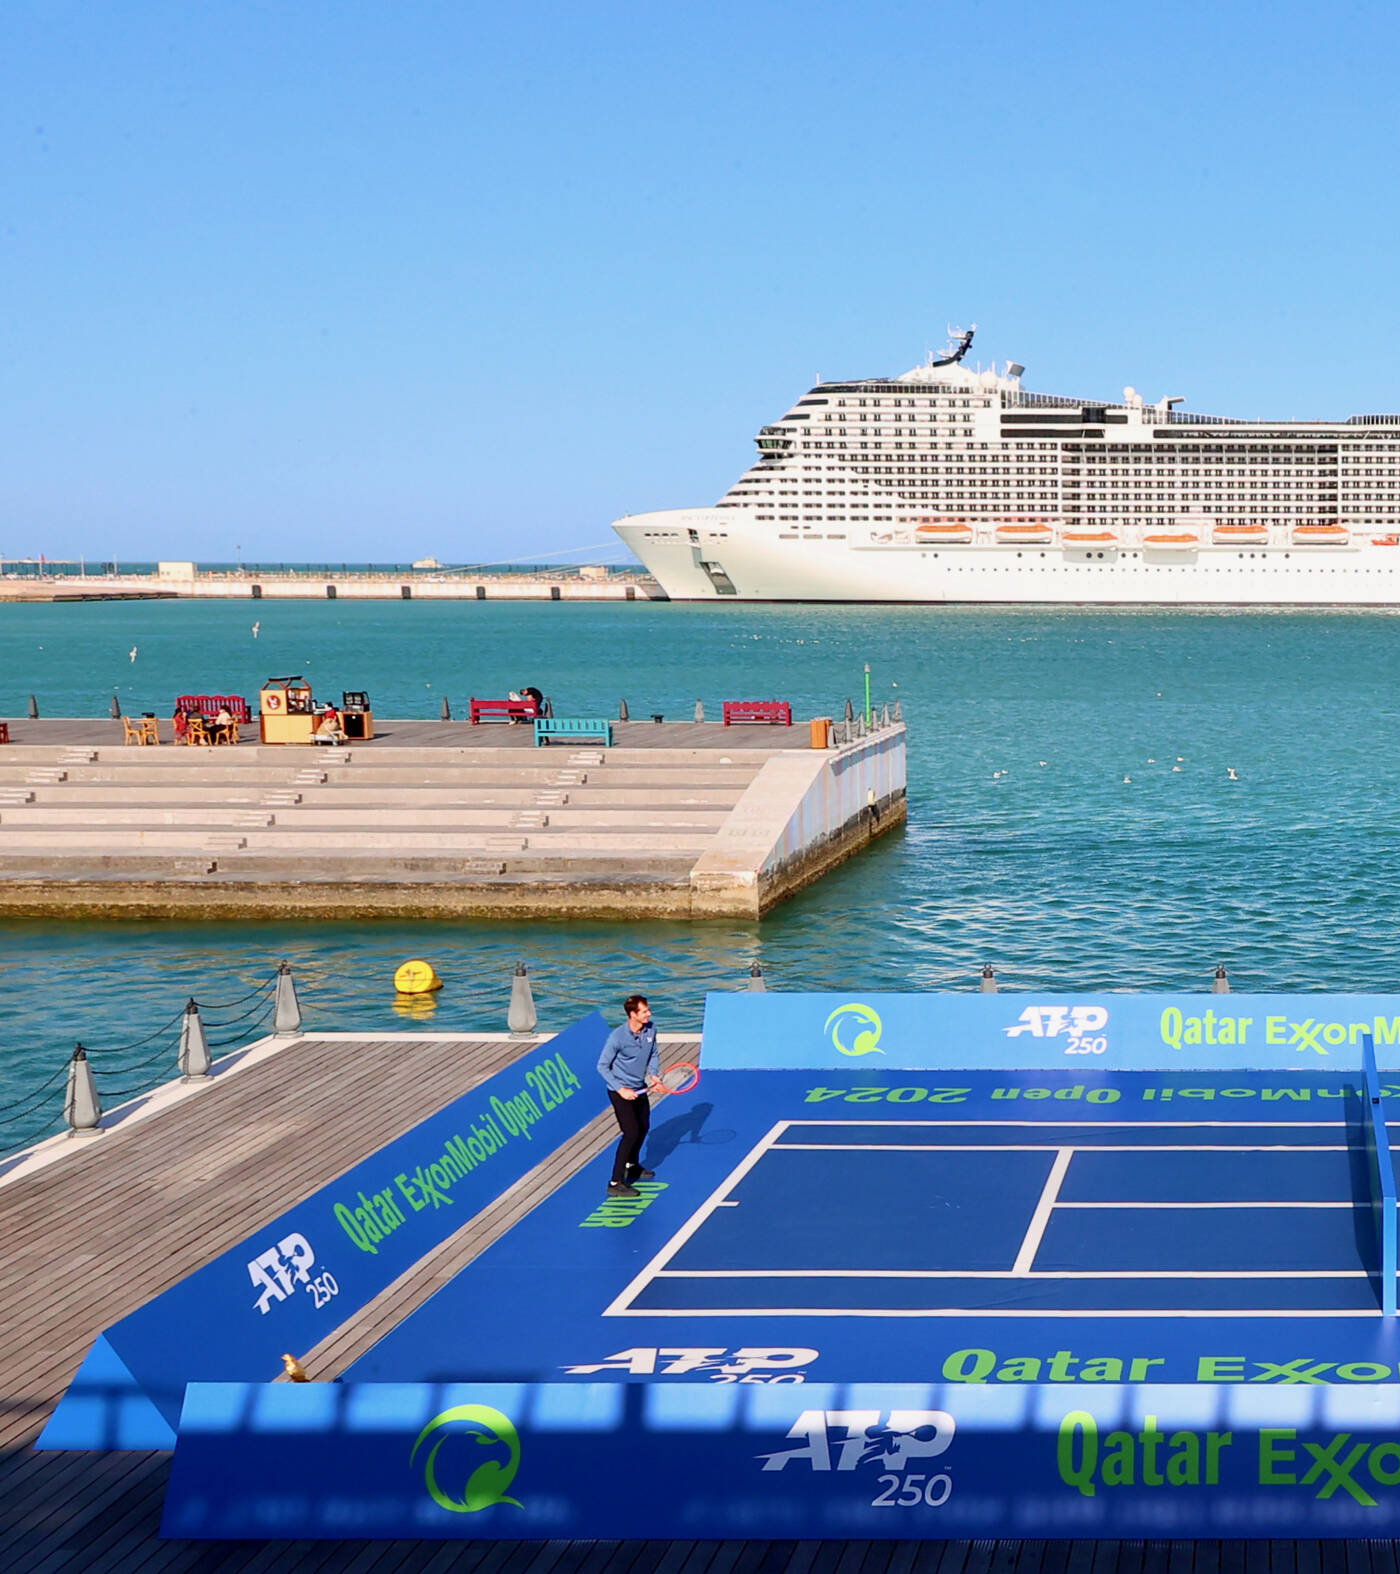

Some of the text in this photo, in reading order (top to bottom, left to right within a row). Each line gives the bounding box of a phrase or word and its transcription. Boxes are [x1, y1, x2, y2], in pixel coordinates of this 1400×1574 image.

[1002, 1005, 1109, 1037] ATP
[1160, 1007, 1252, 1049] Qatar
[1063, 1036, 1108, 1055] 250
[804, 1087, 973, 1103] 2024
[991, 1086, 1121, 1103] Open
[333, 1053, 581, 1255] Qatar ExxonMobil Open 2024
[247, 1232, 316, 1315] ATP
[305, 1271, 340, 1310] 250
[556, 1347, 820, 1374] ATP
[942, 1349, 1165, 1383] Qatar
[752, 1410, 957, 1471] ATP
[1057, 1410, 1233, 1497] Qatar
[870, 1474, 953, 1507] 250
